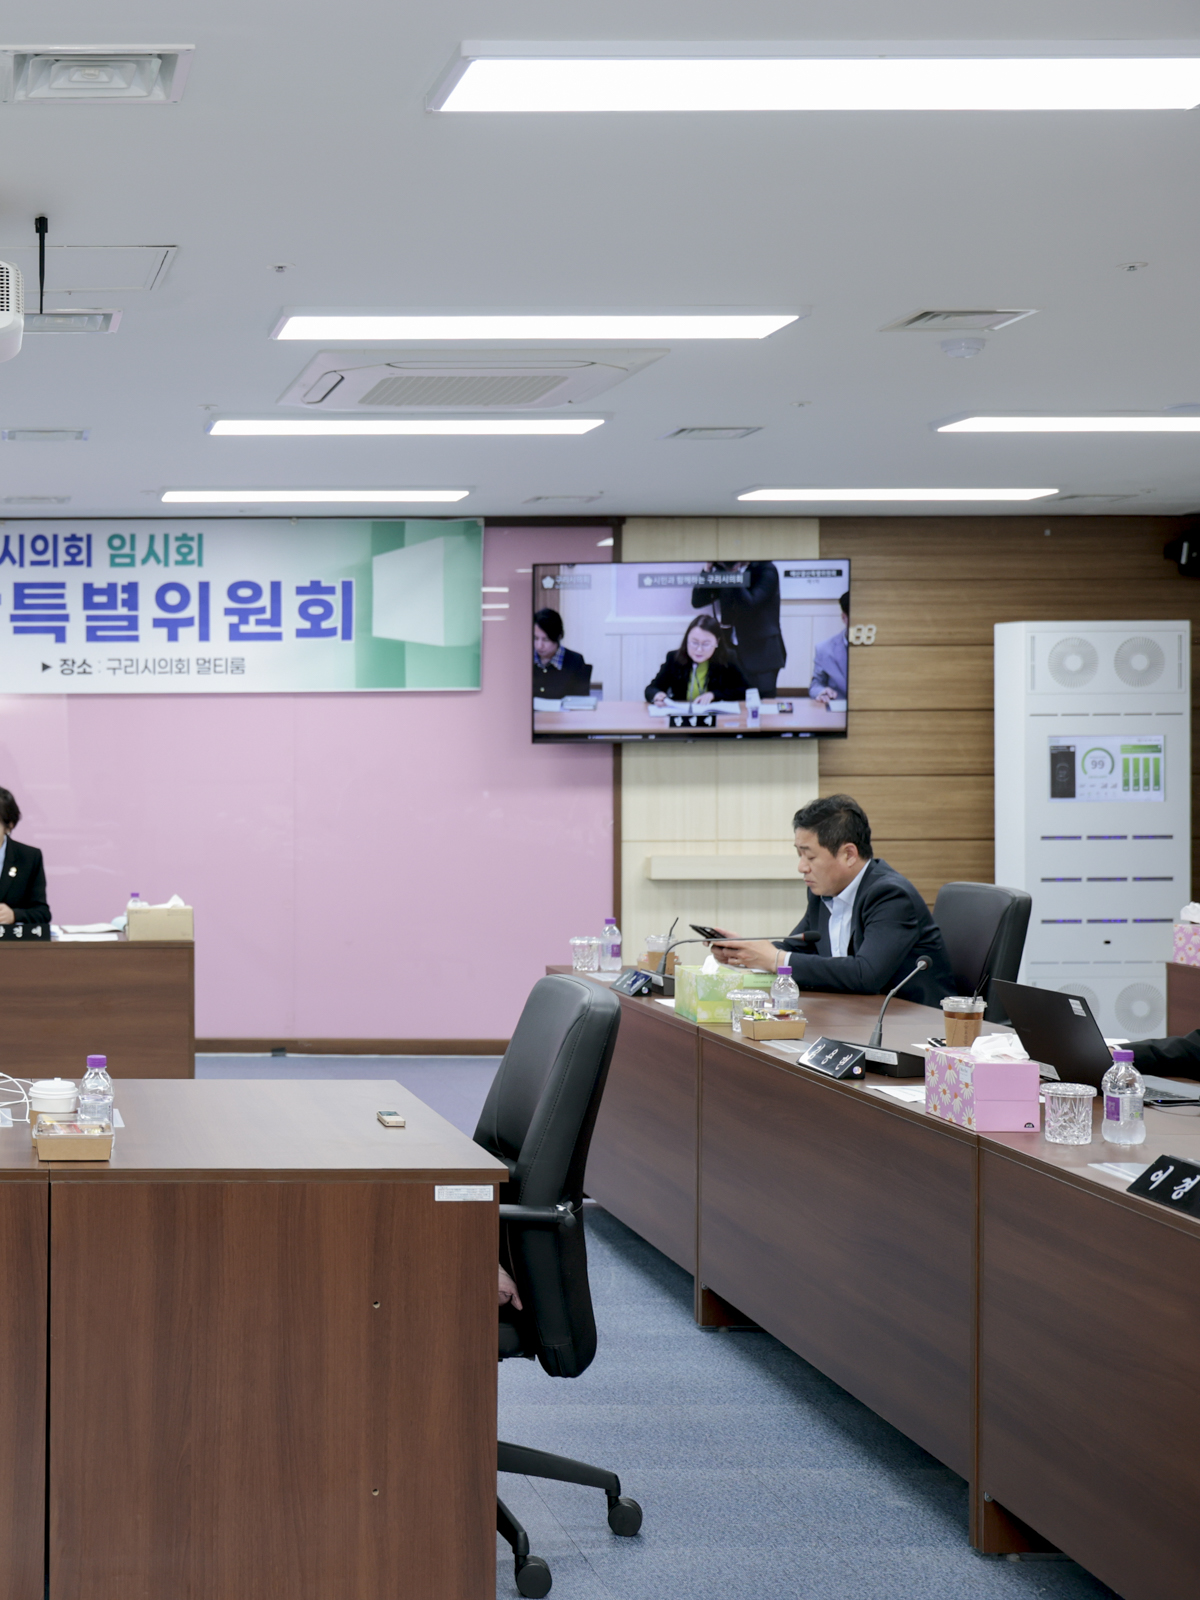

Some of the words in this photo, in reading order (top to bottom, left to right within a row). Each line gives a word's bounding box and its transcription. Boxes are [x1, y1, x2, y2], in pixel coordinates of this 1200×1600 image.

[106, 533, 204, 568] 임시회
[59, 658, 93, 675] 장소
[106, 657, 190, 675] 구리시의회
[196, 656, 246, 675] 멀티룸
[1091, 760, 1105, 769] 99
